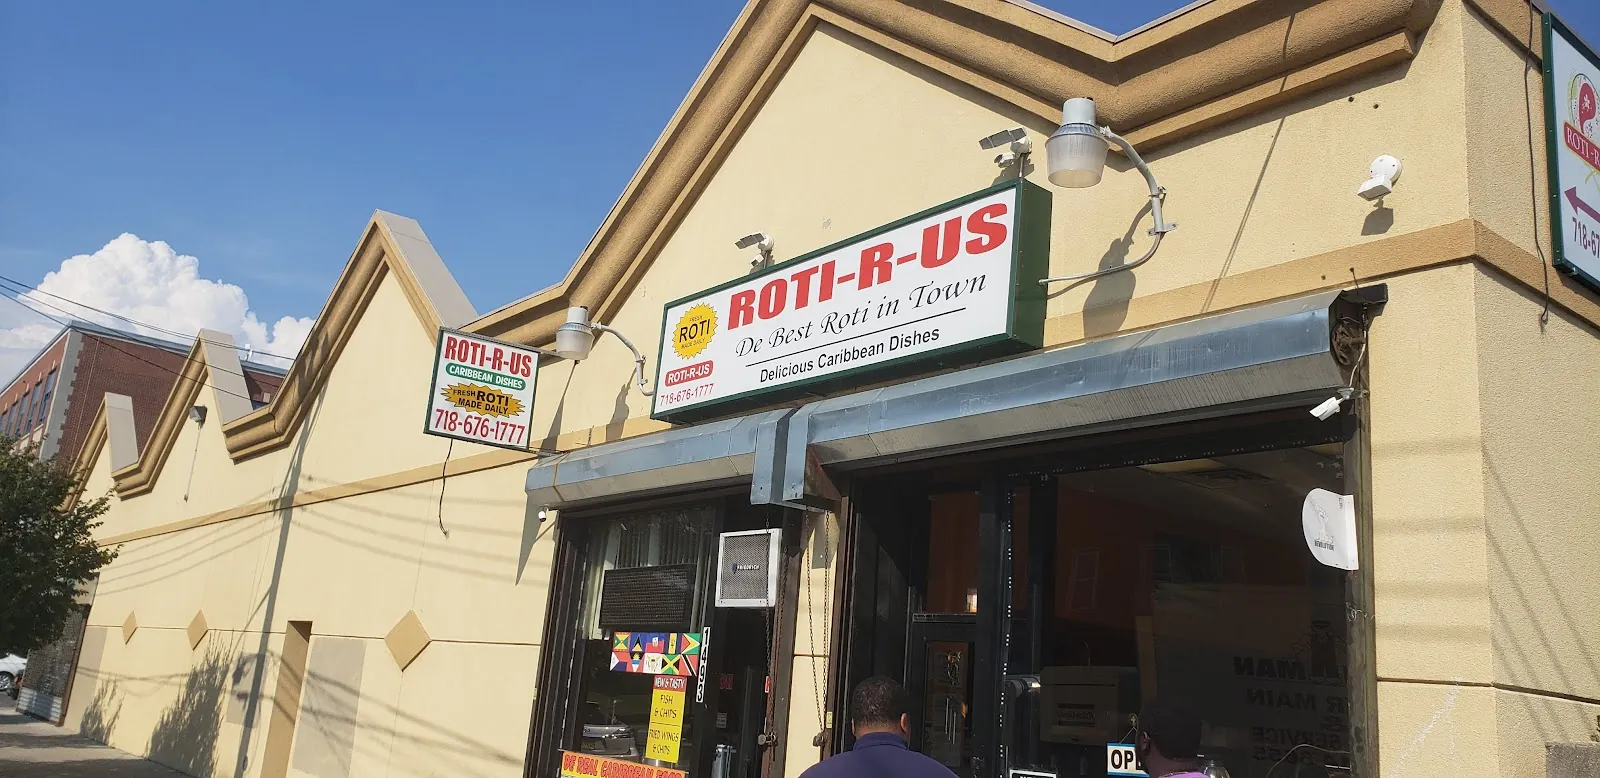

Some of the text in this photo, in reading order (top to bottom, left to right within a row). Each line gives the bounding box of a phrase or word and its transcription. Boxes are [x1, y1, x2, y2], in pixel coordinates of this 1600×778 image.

[727, 202, 1008, 331] ROTI-R-US
[735, 273, 988, 358] De Best Roti in Town
[679, 318, 711, 344] ROTI
[680, 337, 706, 349] MADE DAILY
[444, 336, 532, 378] ROTI-R-US
[759, 325, 940, 384] Delicious Caribbean Dishes
[449, 365, 523, 389] CARIBBEAN DISHES
[667, 363, 710, 384] ROTI-R-US
[453, 389, 509, 406] FRESH ROTI
[660, 383, 714, 406] 718-676-1777
[458, 397, 509, 415] MADE DAILY
[434, 408, 526, 444] 718-676-1777
[697, 627, 709, 702] 1493
[654, 677, 666, 688] NEW
[669, 677, 685, 690] TASTY
[660, 694, 674, 705] FISH
[659, 707, 677, 719] CHIPS
[649, 728, 680, 743] FRIED WINGS
[657, 744, 671, 755] CHIPS
[576, 756, 599, 776] REAL
